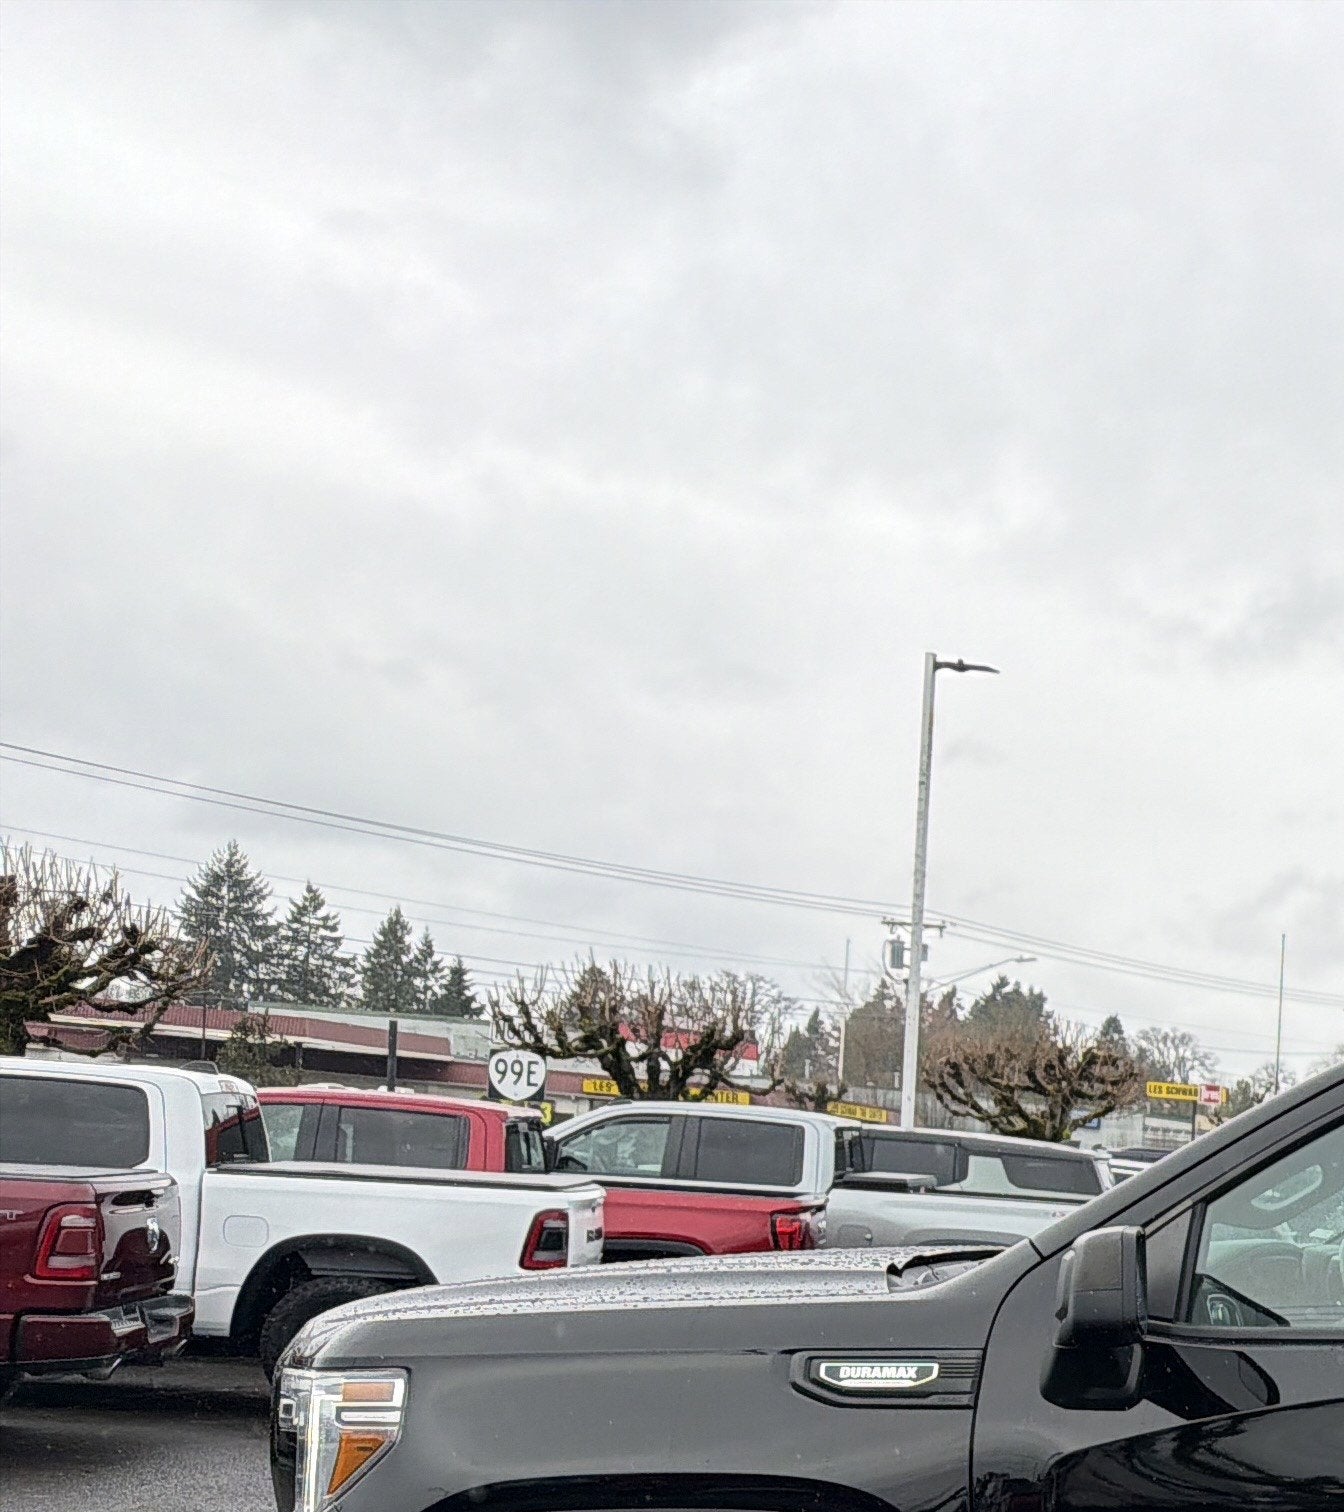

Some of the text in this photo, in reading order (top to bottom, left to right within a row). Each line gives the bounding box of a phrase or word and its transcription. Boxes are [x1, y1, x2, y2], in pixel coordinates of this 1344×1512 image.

[494, 1058, 539, 1087] 99E
[1149, 1084, 1163, 1095] LES
[1166, 1085, 1198, 1097] SCHWAB
[839, 1366, 918, 1379] DURAMAX
